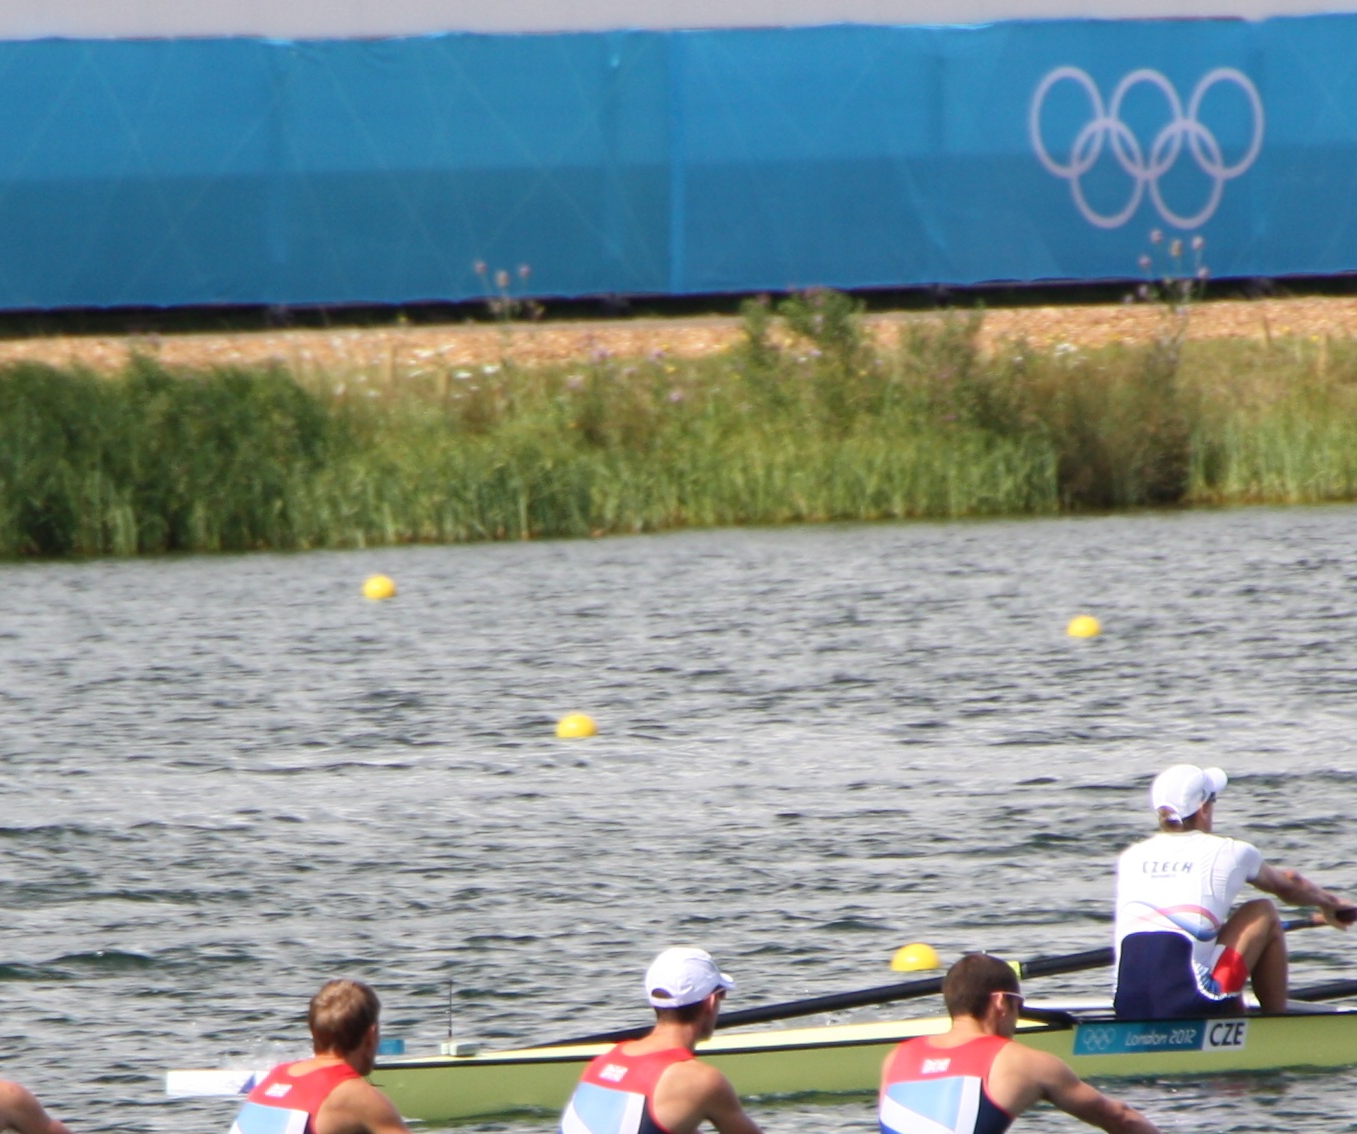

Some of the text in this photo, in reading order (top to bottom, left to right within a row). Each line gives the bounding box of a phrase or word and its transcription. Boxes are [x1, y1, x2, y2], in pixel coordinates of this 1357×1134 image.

[1125, 1028, 1197, 1047] London 2012
[1209, 1022, 1245, 1047] CZE
